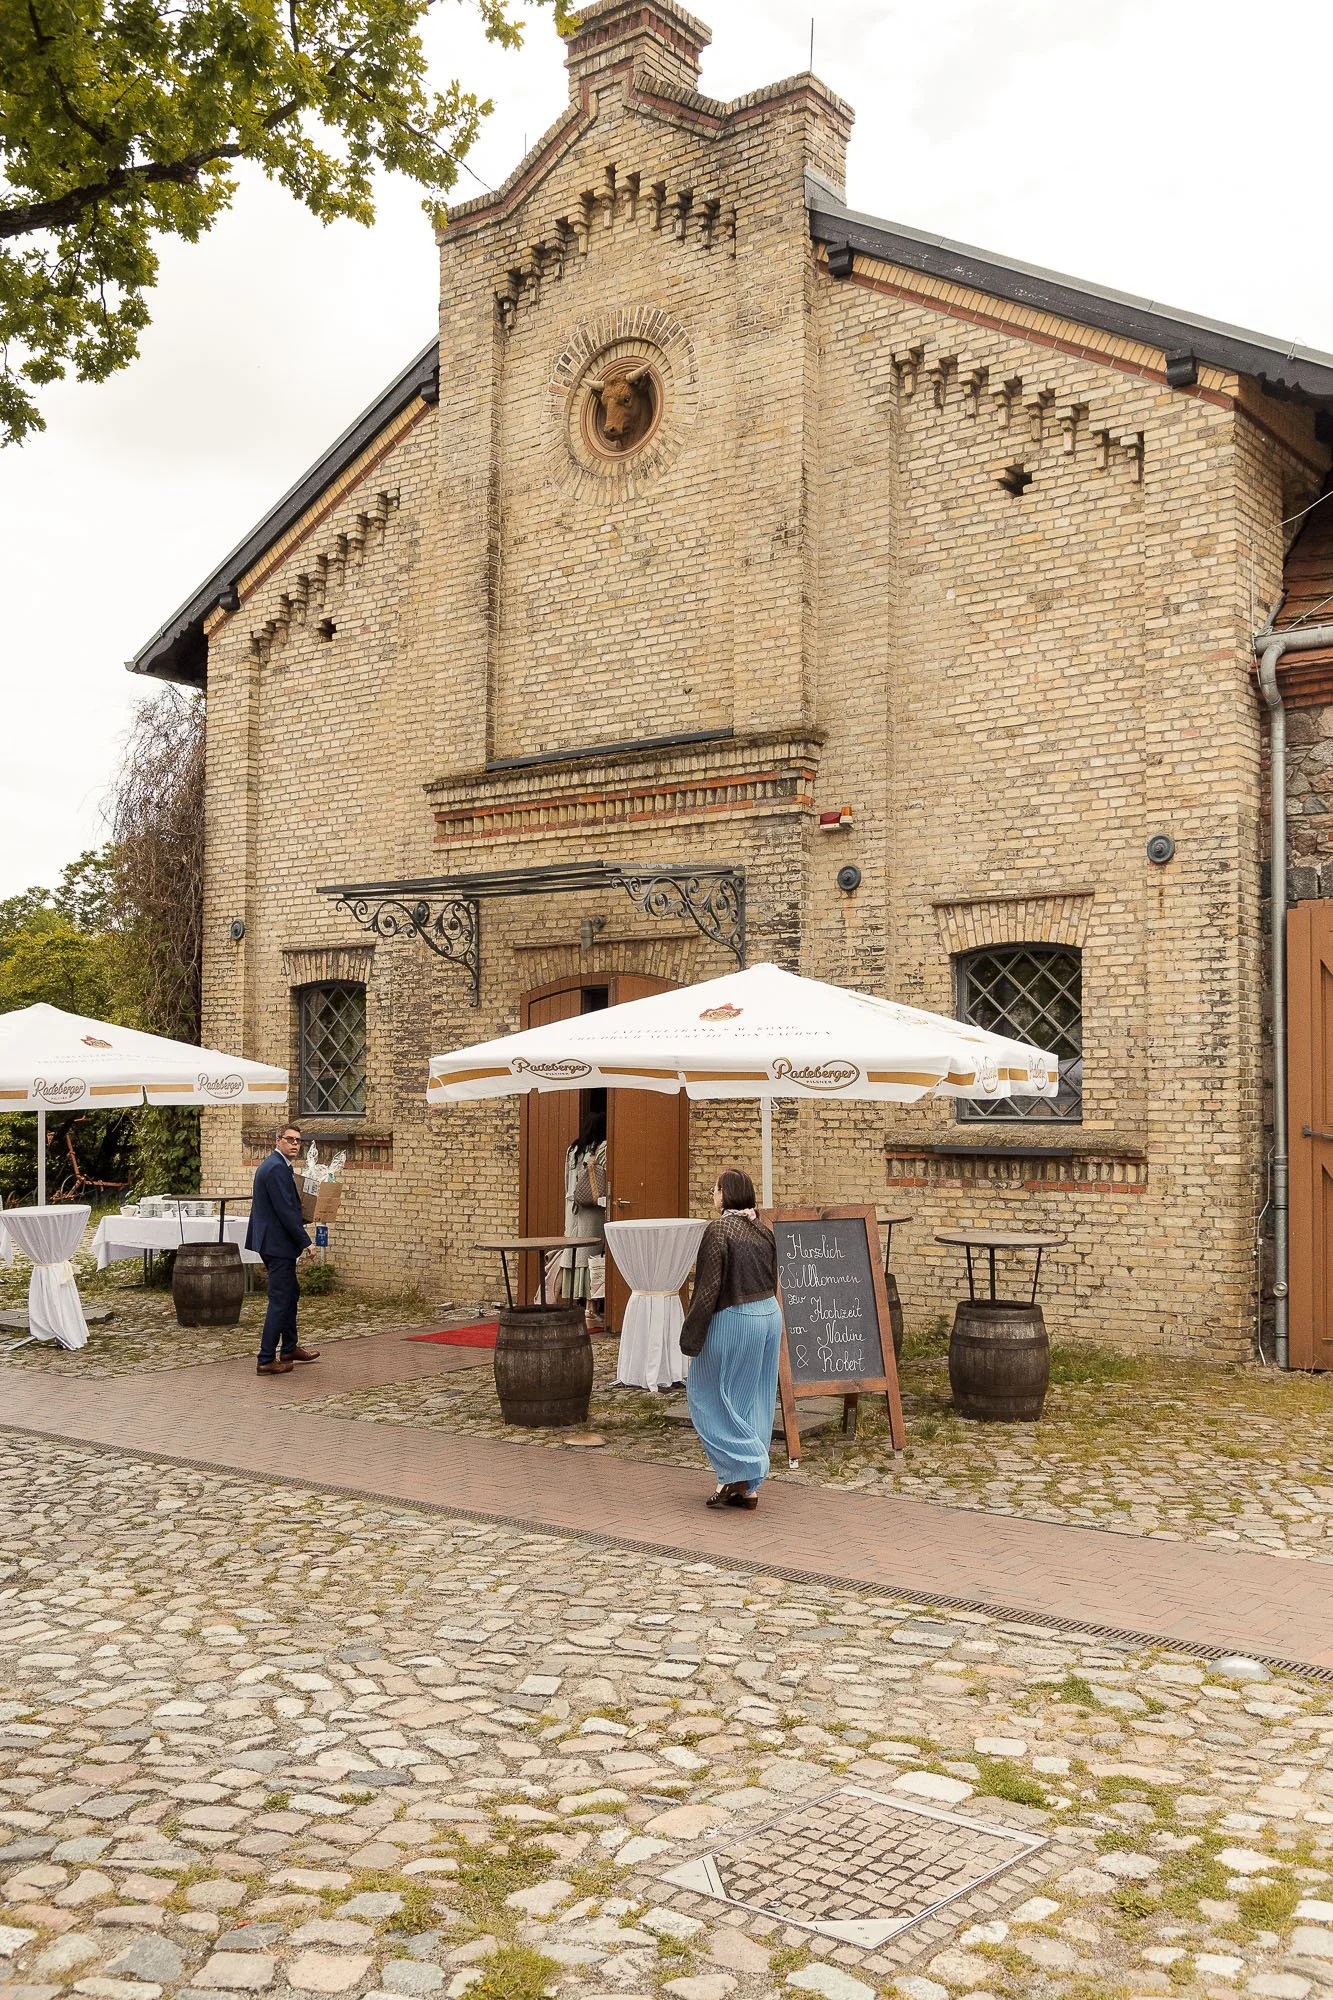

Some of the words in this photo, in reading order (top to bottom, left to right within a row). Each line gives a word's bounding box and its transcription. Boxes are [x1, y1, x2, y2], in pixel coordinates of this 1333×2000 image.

[511, 1056, 589, 1076] Radeberger
[772, 1056, 856, 1083] Radeberger
[32, 1077, 84, 1098] Radeberger
[197, 1072, 242, 1093] Radeberger
[786, 1233, 846, 1260] Herzlich
[779, 1262, 862, 1290] Willkommen
[809, 1297, 863, 1323] Hochzeit
[788, 1325, 808, 1335] von
[816, 1320, 868, 1346] Nadine
[795, 1344, 810, 1369] &
[817, 1346, 866, 1373] Robert
